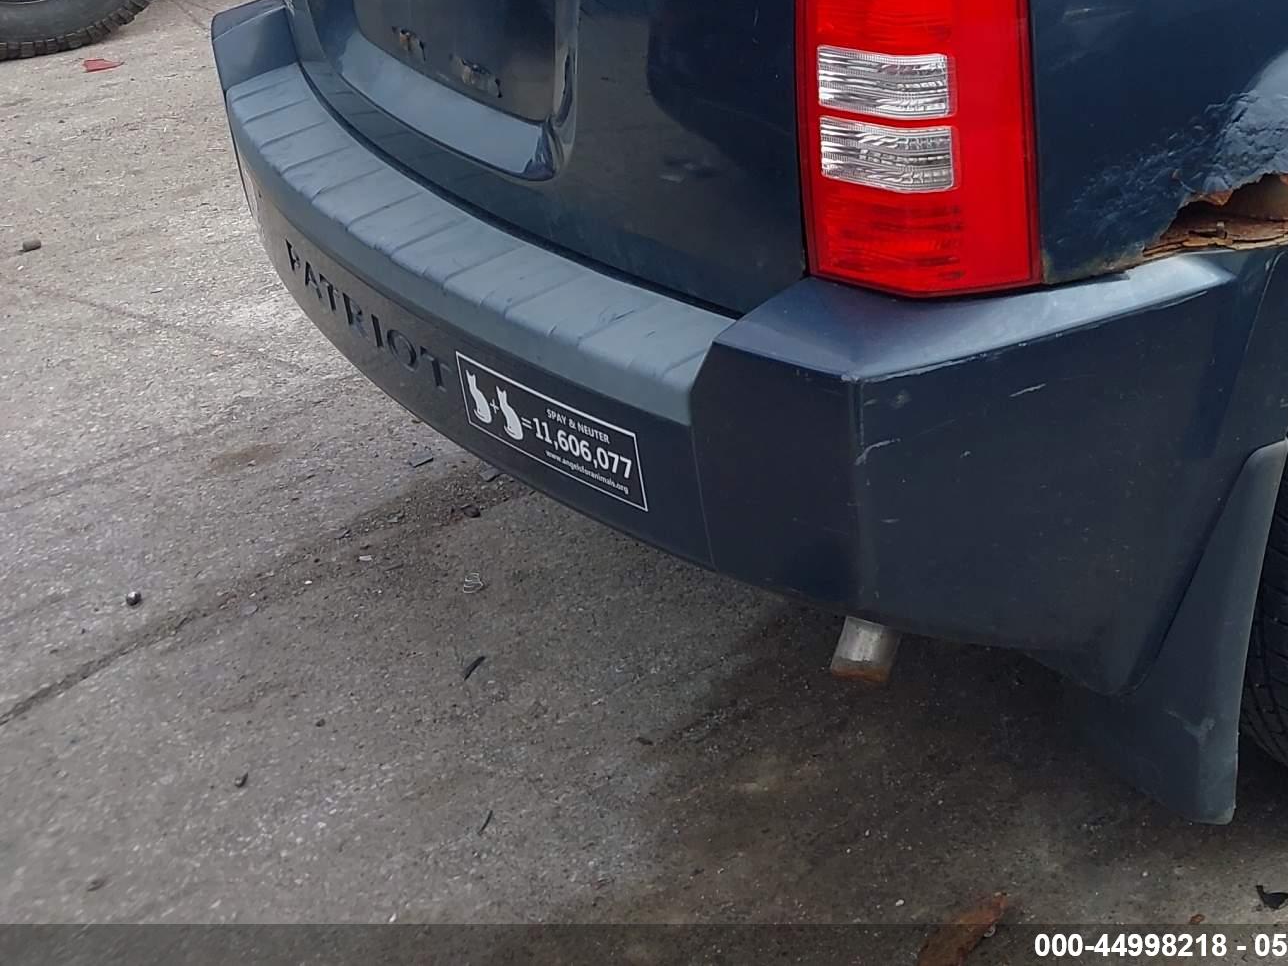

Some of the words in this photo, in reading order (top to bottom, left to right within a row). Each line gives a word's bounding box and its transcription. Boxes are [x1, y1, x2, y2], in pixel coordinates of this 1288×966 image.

[285, 238, 451, 392] PATRIOT
[546, 409, 567, 426] SPAY
[568, 418, 577, 430] &
[577, 422, 611, 445] NEUTER
